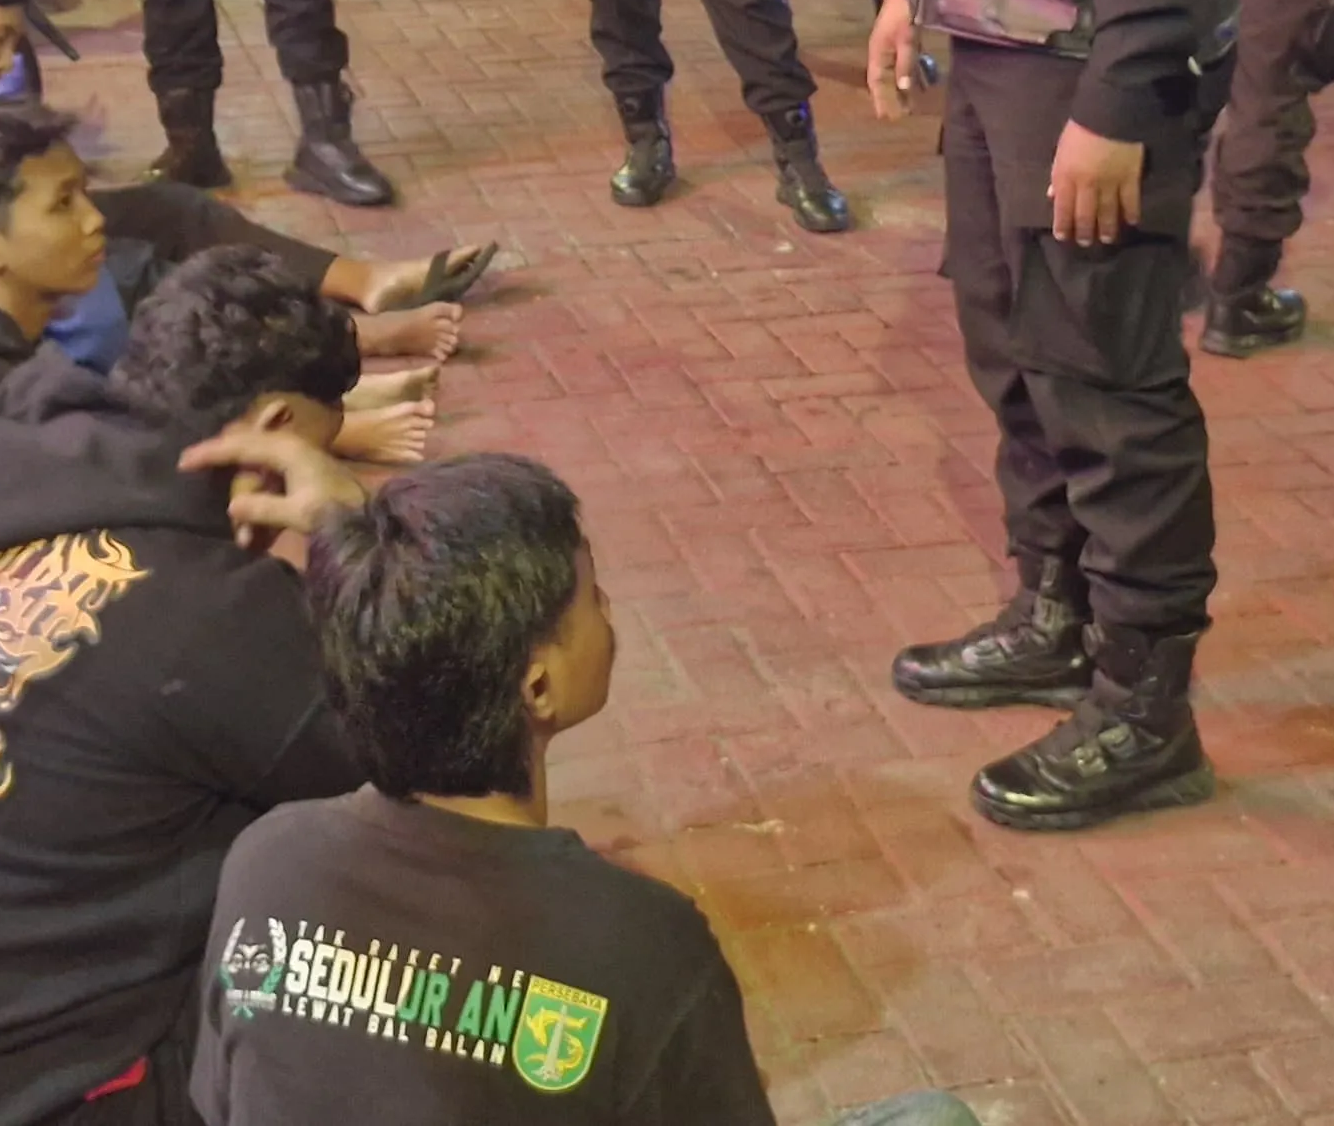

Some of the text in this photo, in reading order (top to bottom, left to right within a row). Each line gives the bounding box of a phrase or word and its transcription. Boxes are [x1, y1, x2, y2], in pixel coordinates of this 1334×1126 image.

[298, 920, 347, 948] TAK
[281, 993, 354, 1028] LEWAT
[367, 1014, 410, 1042] BAL
[425, 1027, 506, 1066] BALAN
[456, 979, 522, 1044] AN
